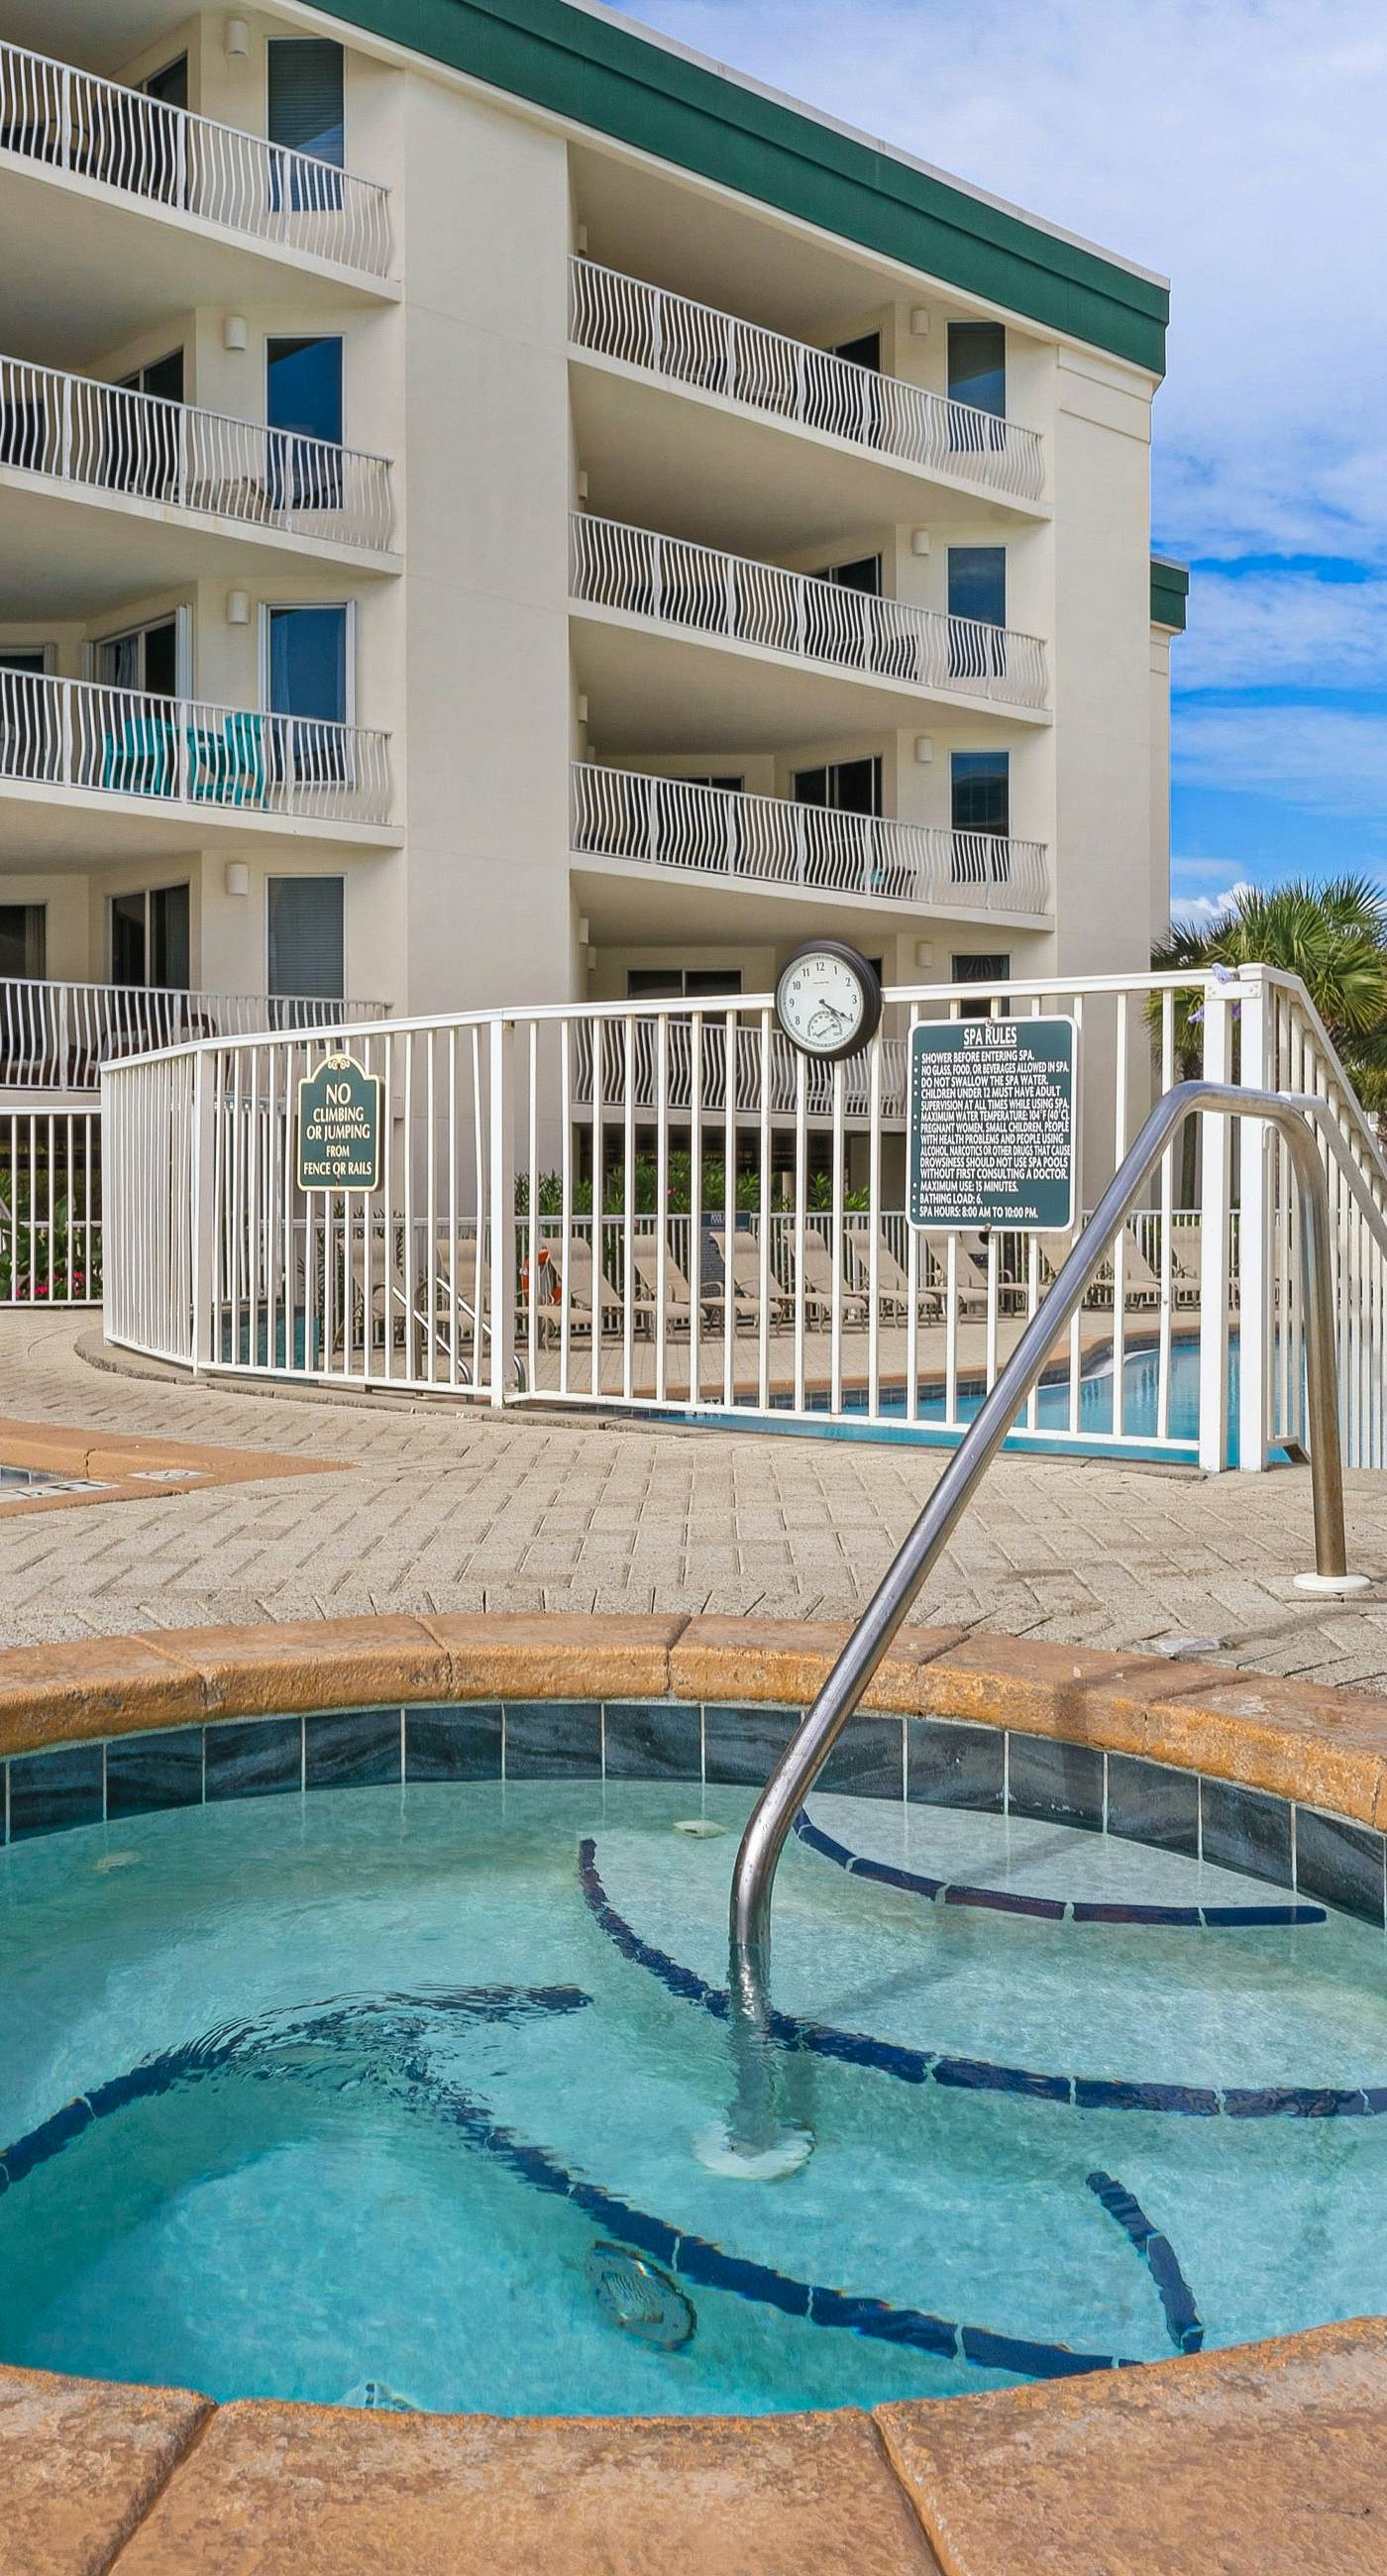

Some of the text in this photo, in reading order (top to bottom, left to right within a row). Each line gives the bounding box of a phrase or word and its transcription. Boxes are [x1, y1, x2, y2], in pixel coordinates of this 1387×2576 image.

[801, 968, 809, 977] 11
[816, 962, 824, 971] 12
[834, 965, 838, 975] 1
[793, 981, 801, 990] 10
[845, 977, 851, 987] 2
[789, 998, 795, 1007] 9
[851, 995, 857, 1004] 3
[795, 1016, 800, 1025] 8
[963, 1026, 1016, 1045] SPA RULES
[921, 1050, 1034, 1063] SHOWER BEFORE ENTERING SPA.
[921, 1065, 932, 1076] NO
[953, 1064, 972, 1076] FOOD,
[973, 1064, 982, 1074] OR
[983, 1063, 1015, 1074] BEVERAGES
[1016, 1062, 1046, 1073] ALLOWED
[1048, 1062, 1055, 1072] IN
[1056, 1061, 1069, 1072] SPA.
[921, 1075, 1048, 1087] DO NOT SWALLOW THE SPA WATER.
[326, 1083, 352, 1105] NO
[921, 1086, 1061, 1099] CHILDREN UNDER 12 MUST HAVE ADULT
[921, 1098, 1069, 1111] SUPERVISION AT ALL TIMES WHILE USING SPA.
[313, 1106, 364, 1123] CLIMBING
[921, 1111, 954, 1122] MAXIMUM
[956, 1111, 979, 1122] WATER
[980, 1110, 1027, 1121] TEMPERATURE:
[306, 1124, 371, 1141] OR JUMPING
[921, 1123, 955, 1133] PREGNANT
[986, 1122, 1008, 1132] SMALL
[1045, 1121, 1069, 1131] PEOPLE
[920, 1133, 1063, 1145] WITH HEALTH PROBLEMS AND PEOPLE USING
[326, 1144, 350, 1157] FROM
[950, 1145, 983, 1156] NARCOTICS
[983, 1145, 992, 1156] OR
[992, 1145, 1012, 1155] OTHER
[1013, 1145, 1033, 1155] DRUGS
[1034, 1145, 1050, 1155] THAT
[1050, 1145, 1070, 1155] CAUSE
[303, 1161, 373, 1175] FENCE OR RAILS
[920, 1156, 1068, 1168] DROWSINESS SHOULD NOT USE SPA POOLS
[920, 1168, 1068, 1179] WITHOUT FIRST CONSULTING A DOCTOR.
[920, 1181, 1018, 1192] MAXIMUM USE: 15 MINUTES.
[919, 1193, 983, 1204] BATHING LOAD: 6.
[919, 1206, 1038, 1218] SPA HOURS: 8:00 AM TO 10:00 PM.
